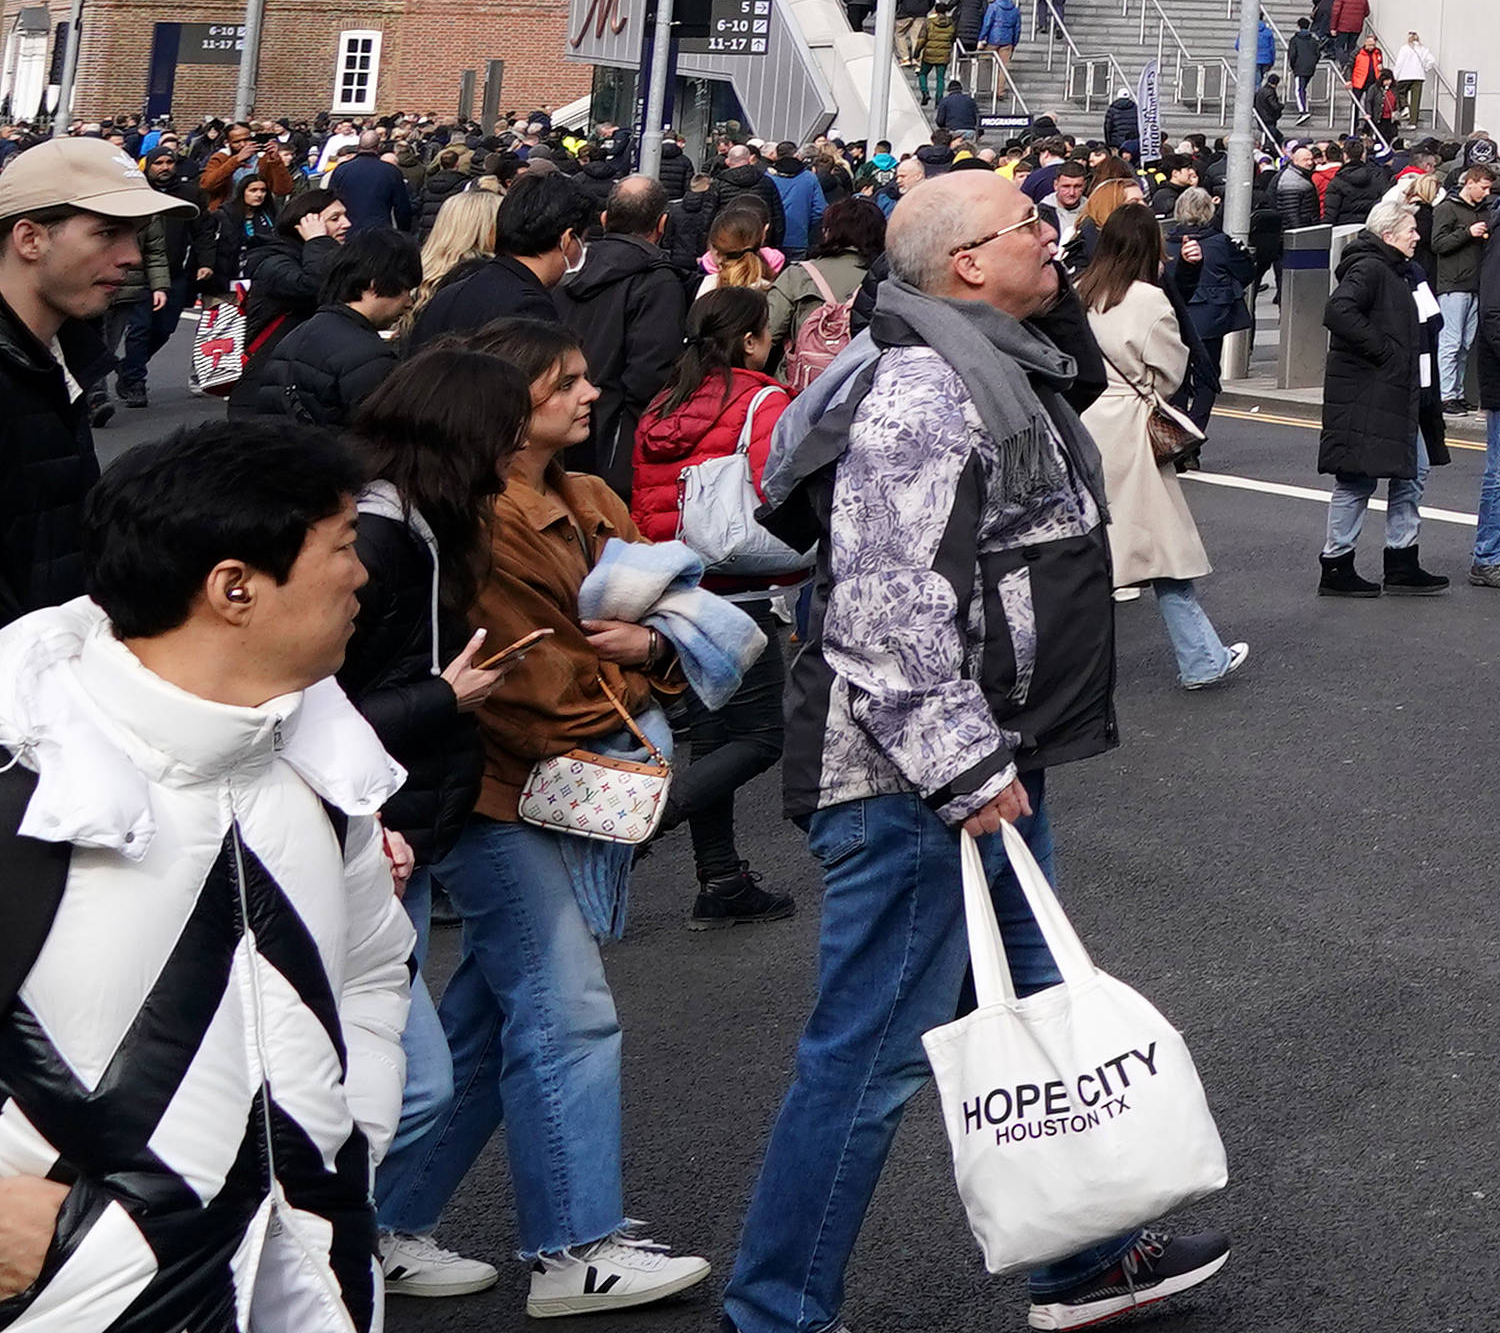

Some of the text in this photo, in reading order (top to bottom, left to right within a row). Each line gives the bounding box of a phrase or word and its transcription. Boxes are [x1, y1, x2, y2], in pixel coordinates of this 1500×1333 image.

[741, 1, 750, 13] 5
[209, 26, 235, 36] 6-10
[717, 19, 749, 32] 6-10
[202, 39, 233, 49] 11-17
[708, 37, 747, 50] 11-17
[963, 1041, 1158, 1135] HOPE CITY
[996, 1094, 1131, 1145] HOUSTON TX
